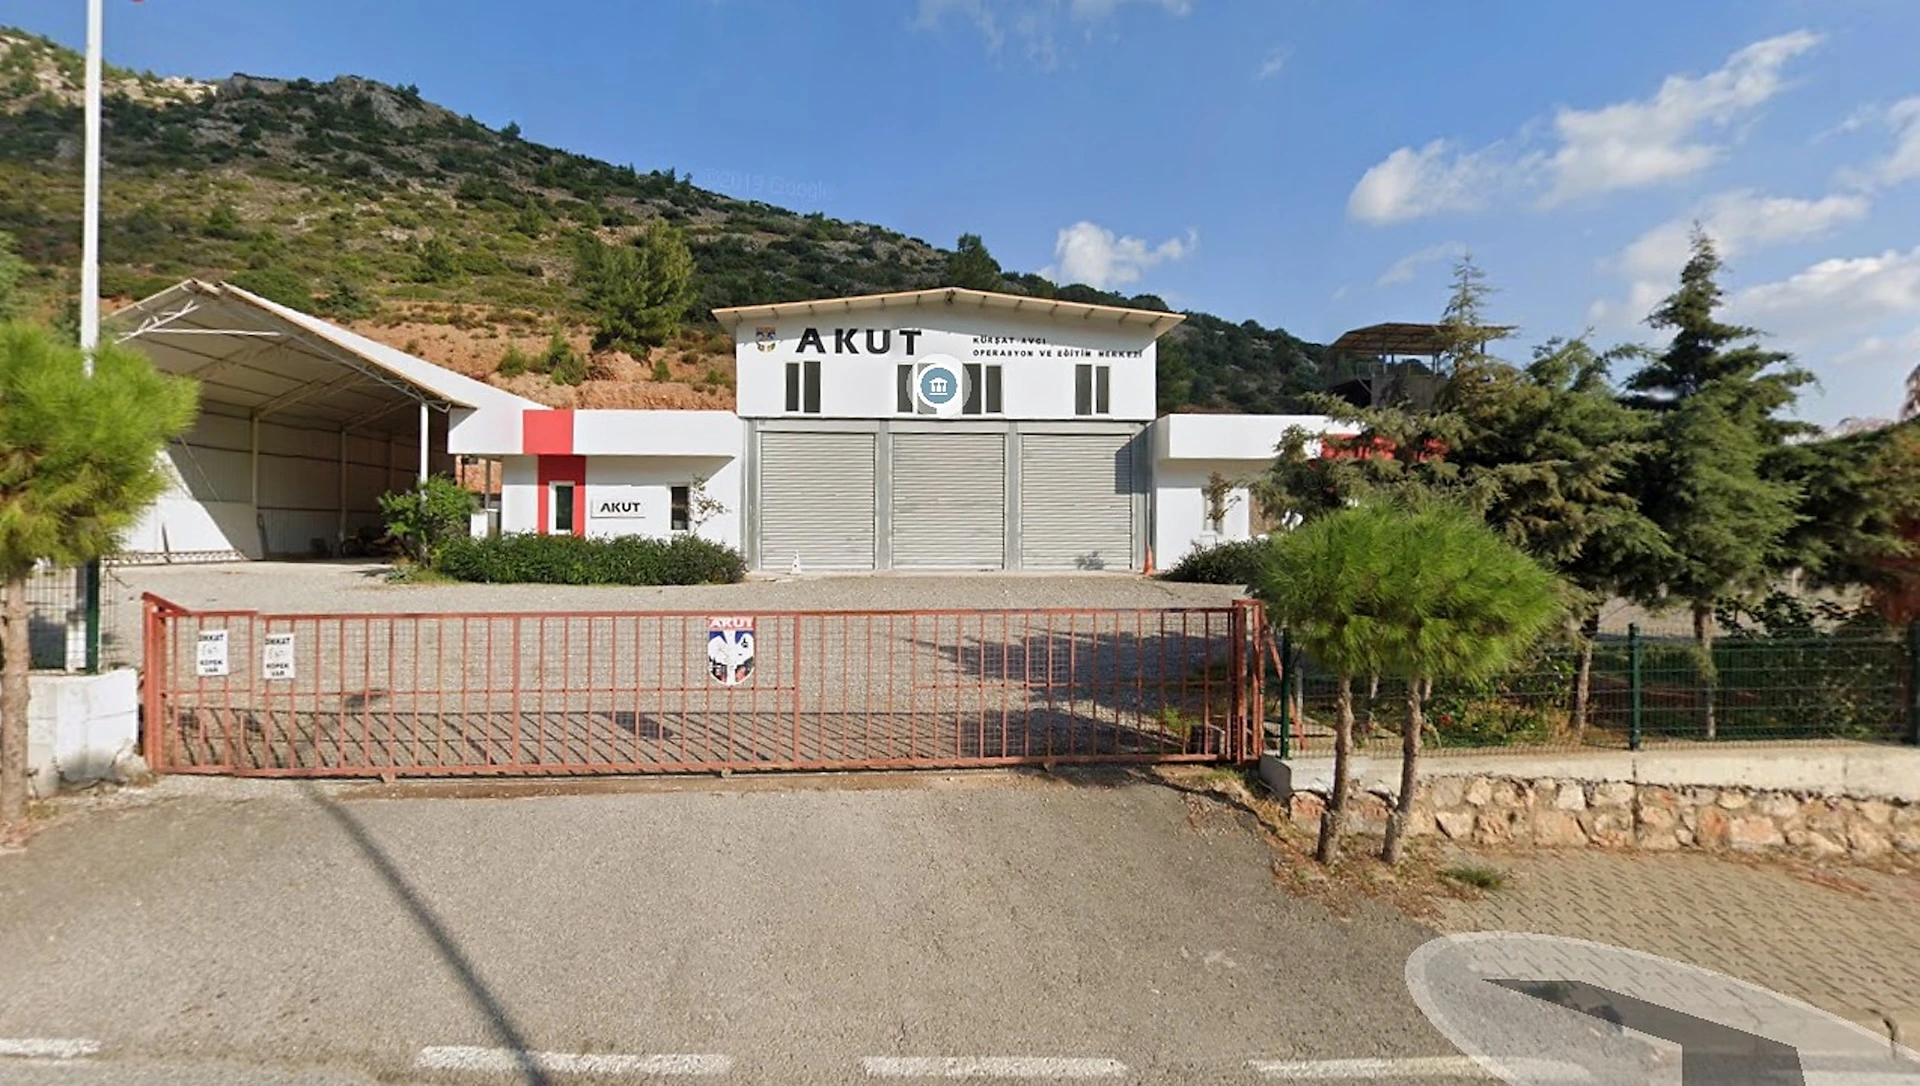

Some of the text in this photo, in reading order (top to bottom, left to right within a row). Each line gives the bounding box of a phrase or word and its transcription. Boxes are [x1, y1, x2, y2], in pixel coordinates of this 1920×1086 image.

[796, 327, 922, 356] AKUT
[973, 349, 1033, 357] OPERASYON
[600, 502, 641, 513] AKUT
[709, 616, 753, 629] AKUT
